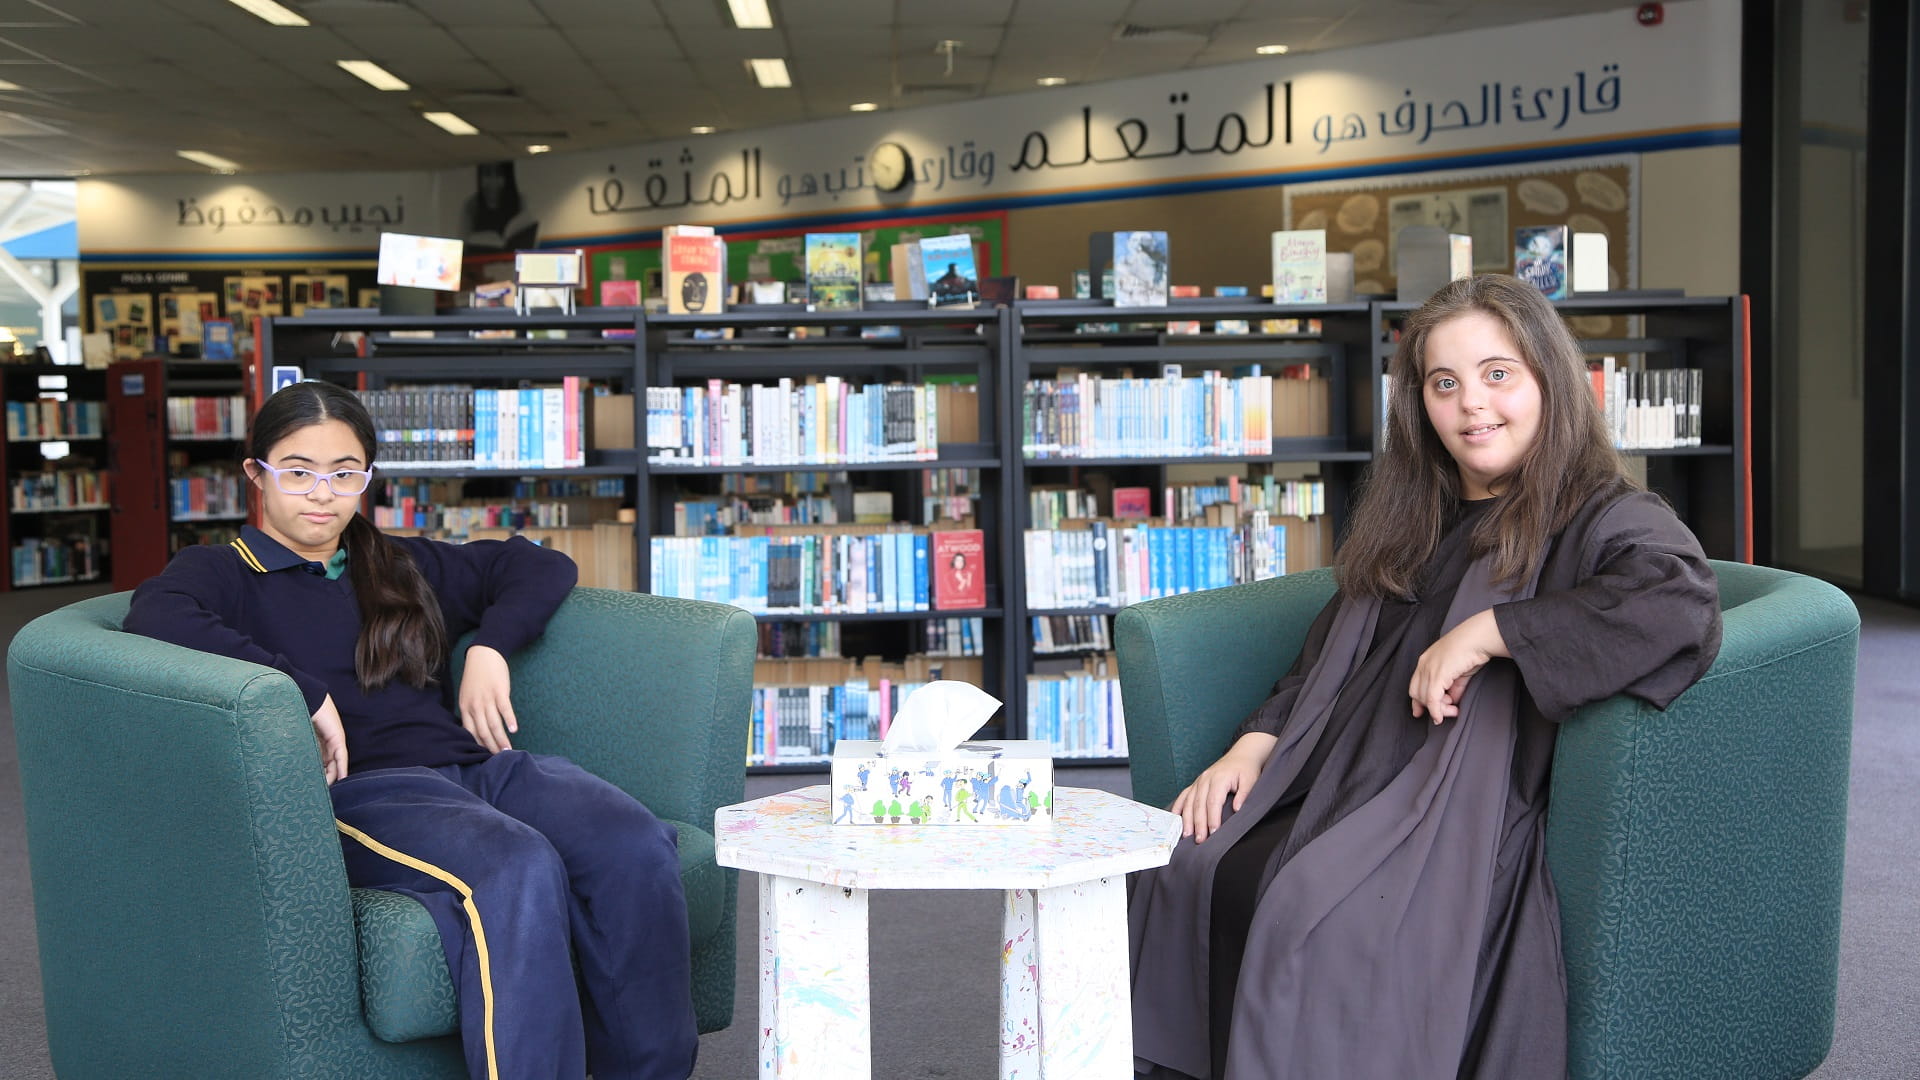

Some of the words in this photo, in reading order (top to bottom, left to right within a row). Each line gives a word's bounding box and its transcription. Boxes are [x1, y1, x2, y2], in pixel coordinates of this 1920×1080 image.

[1377, 83, 1501, 144] الحرف
[1511, 65, 1622, 130] قارئ
[1010, 81, 1293, 172] المتعلم
[1312, 112, 1367, 154] هو
[587, 147, 762, 216] المثقف
[777, 172, 819, 207] هو
[177, 197, 314, 232] محفوظ
[321, 197, 405, 232] نجيب
